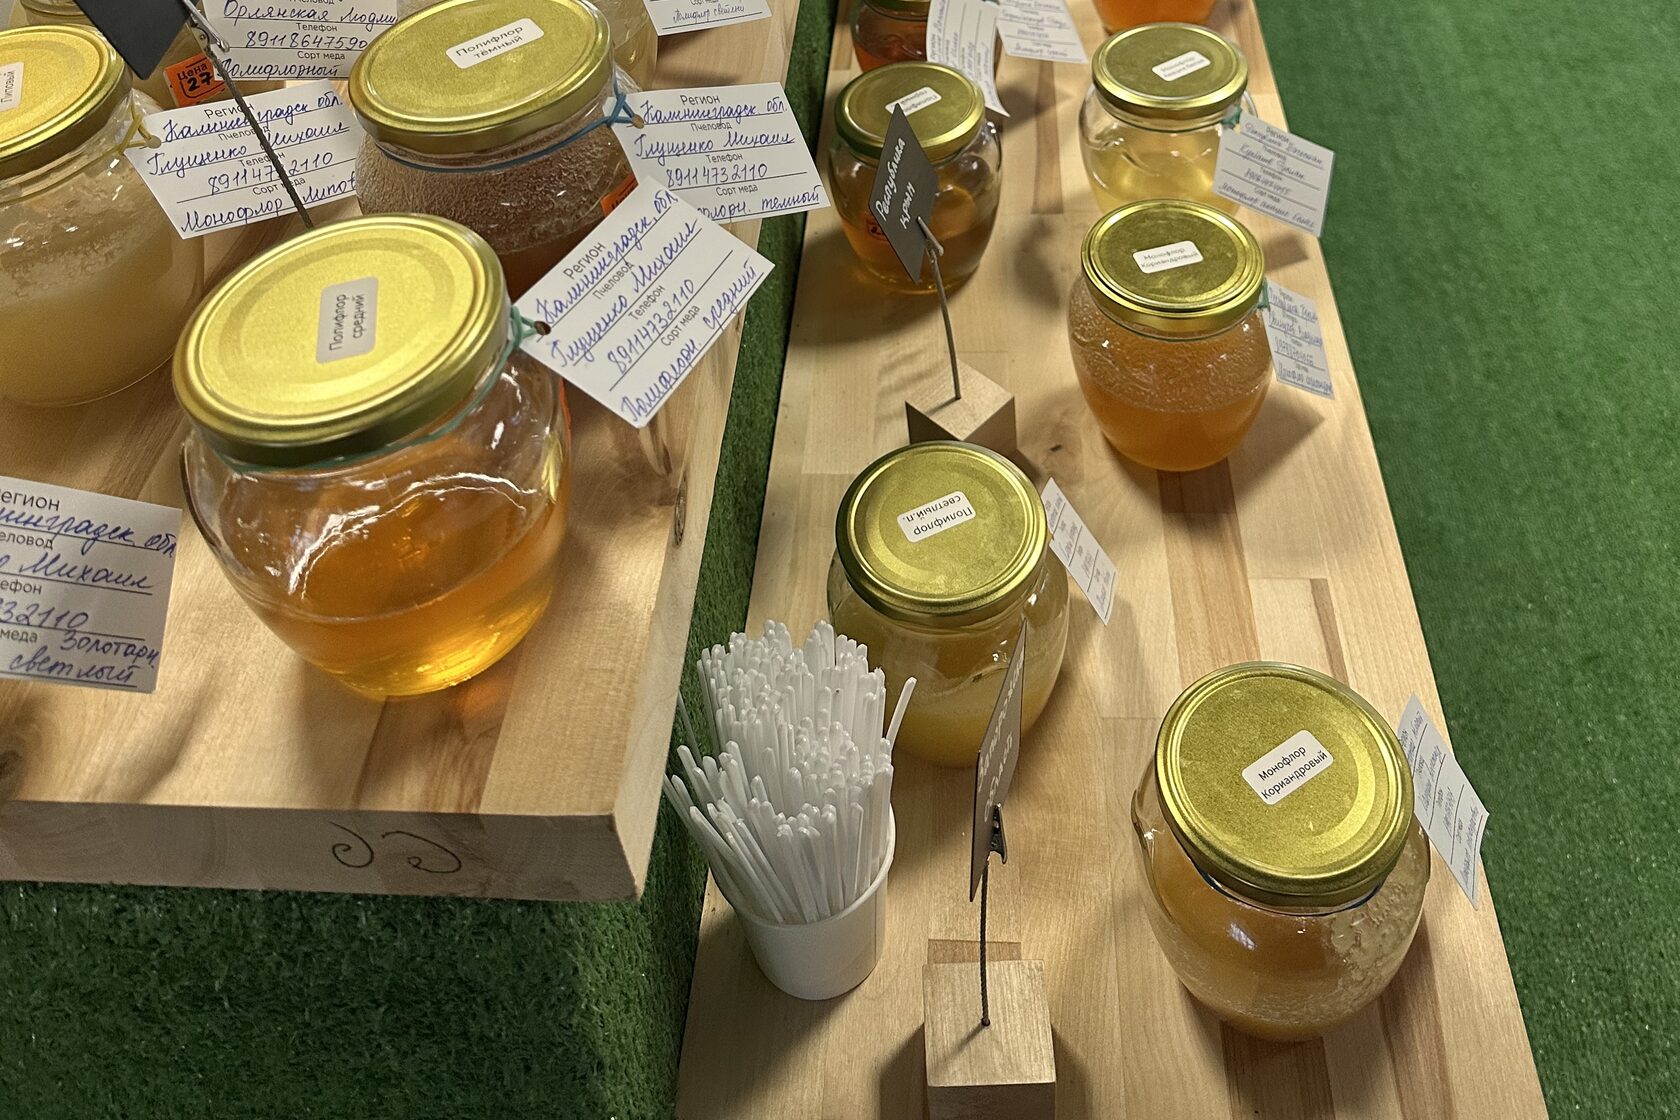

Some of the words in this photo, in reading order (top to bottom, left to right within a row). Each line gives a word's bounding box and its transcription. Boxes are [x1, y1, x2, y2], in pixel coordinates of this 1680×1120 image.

[295, 22, 338, 33] Телефон
[454, 25, 524, 58] Полифлор
[297, 50, 320, 61] Сорт
[322, 51, 346, 61] меда
[176, 62, 208, 81] Цена
[679, 94, 721, 106] Регион
[690, 122, 733, 132] Пчеловод
[705, 152, 744, 164] Телефон
[252, 183, 278, 196] Сорт
[716, 186, 737, 197] Сорт
[739, 184, 759, 195] меда
[562, 241, 607, 280] Регион
[591, 261, 636, 301] Пчеловод
[351, 293, 367, 340] средний
[627, 283, 666, 321] Телефон
[328, 293, 350, 352] Полифлор
[660, 325, 681, 347] Сорт
[677, 304, 701, 328] меда
[913, 507, 973, 536] Полифлор
[1257, 745, 1307, 782] Монофлор
[1260, 749, 1329, 801] Кориандровый
